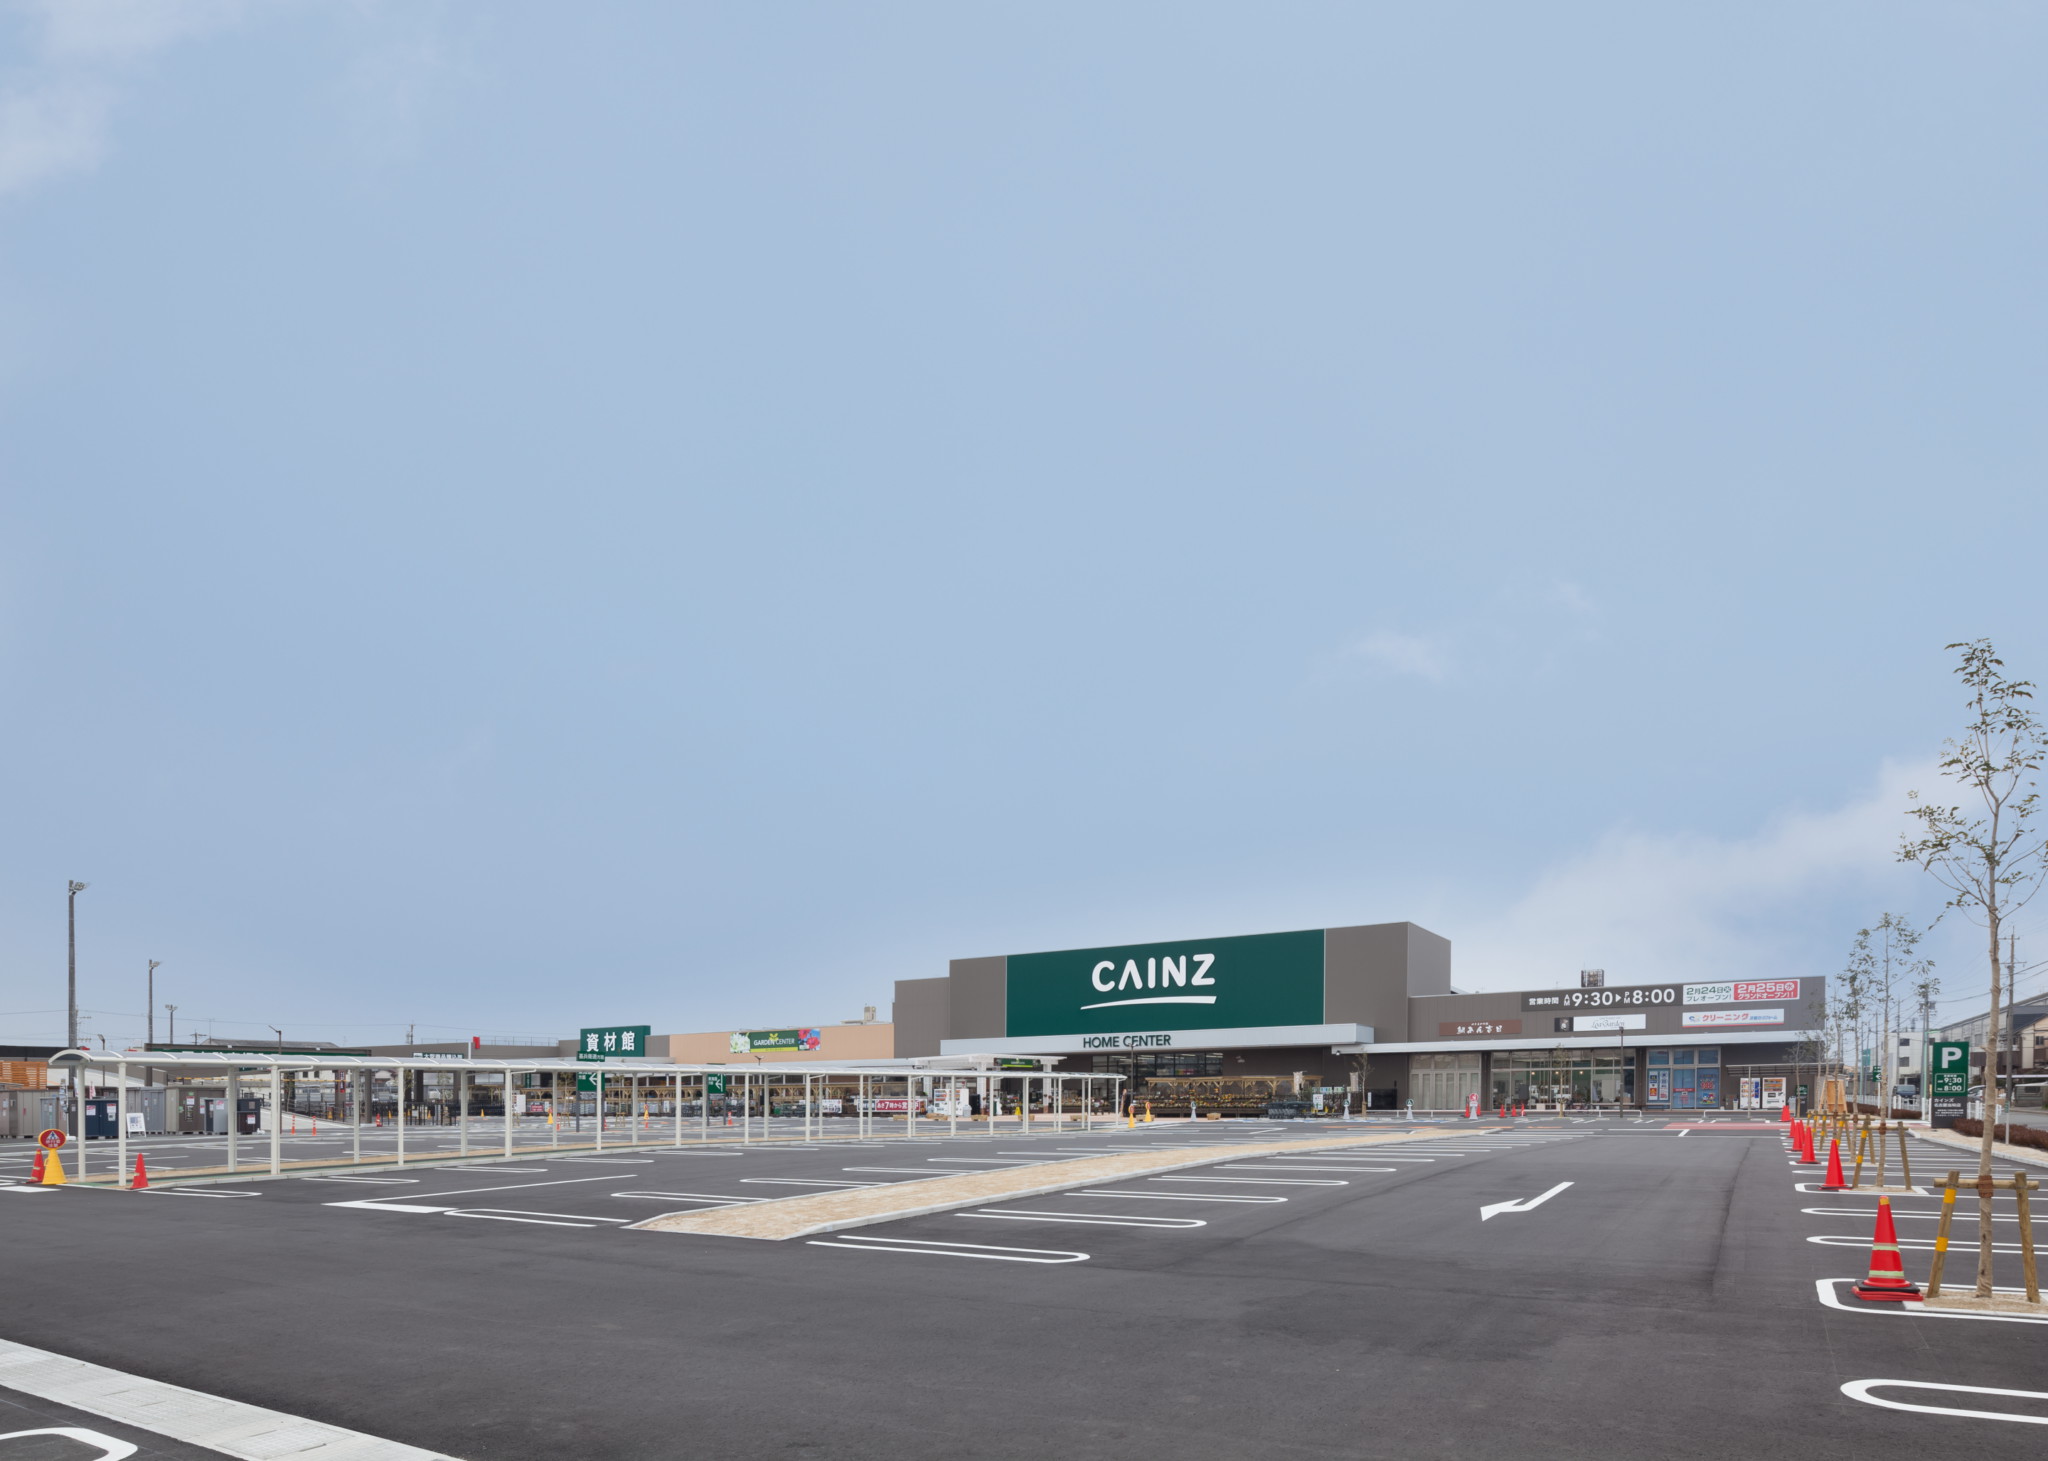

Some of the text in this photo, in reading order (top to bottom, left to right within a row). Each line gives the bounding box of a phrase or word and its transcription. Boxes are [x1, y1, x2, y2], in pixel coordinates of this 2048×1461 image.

[1091, 953, 1216, 992] CAINZ
[1529, 997, 1559, 1006] 営業時間
[1572, 991, 1613, 1007] 9:30
[1632, 988, 1676, 1005] 8:00
[1702, 1013, 1749, 1021] クリーニング
[586, 1031, 635, 1052] 資材館
[753, 1038, 775, 1046] GARDEN
[1083, 1034, 1171, 1048] HOME CENTER
[1942, 1047, 1962, 1068] P
